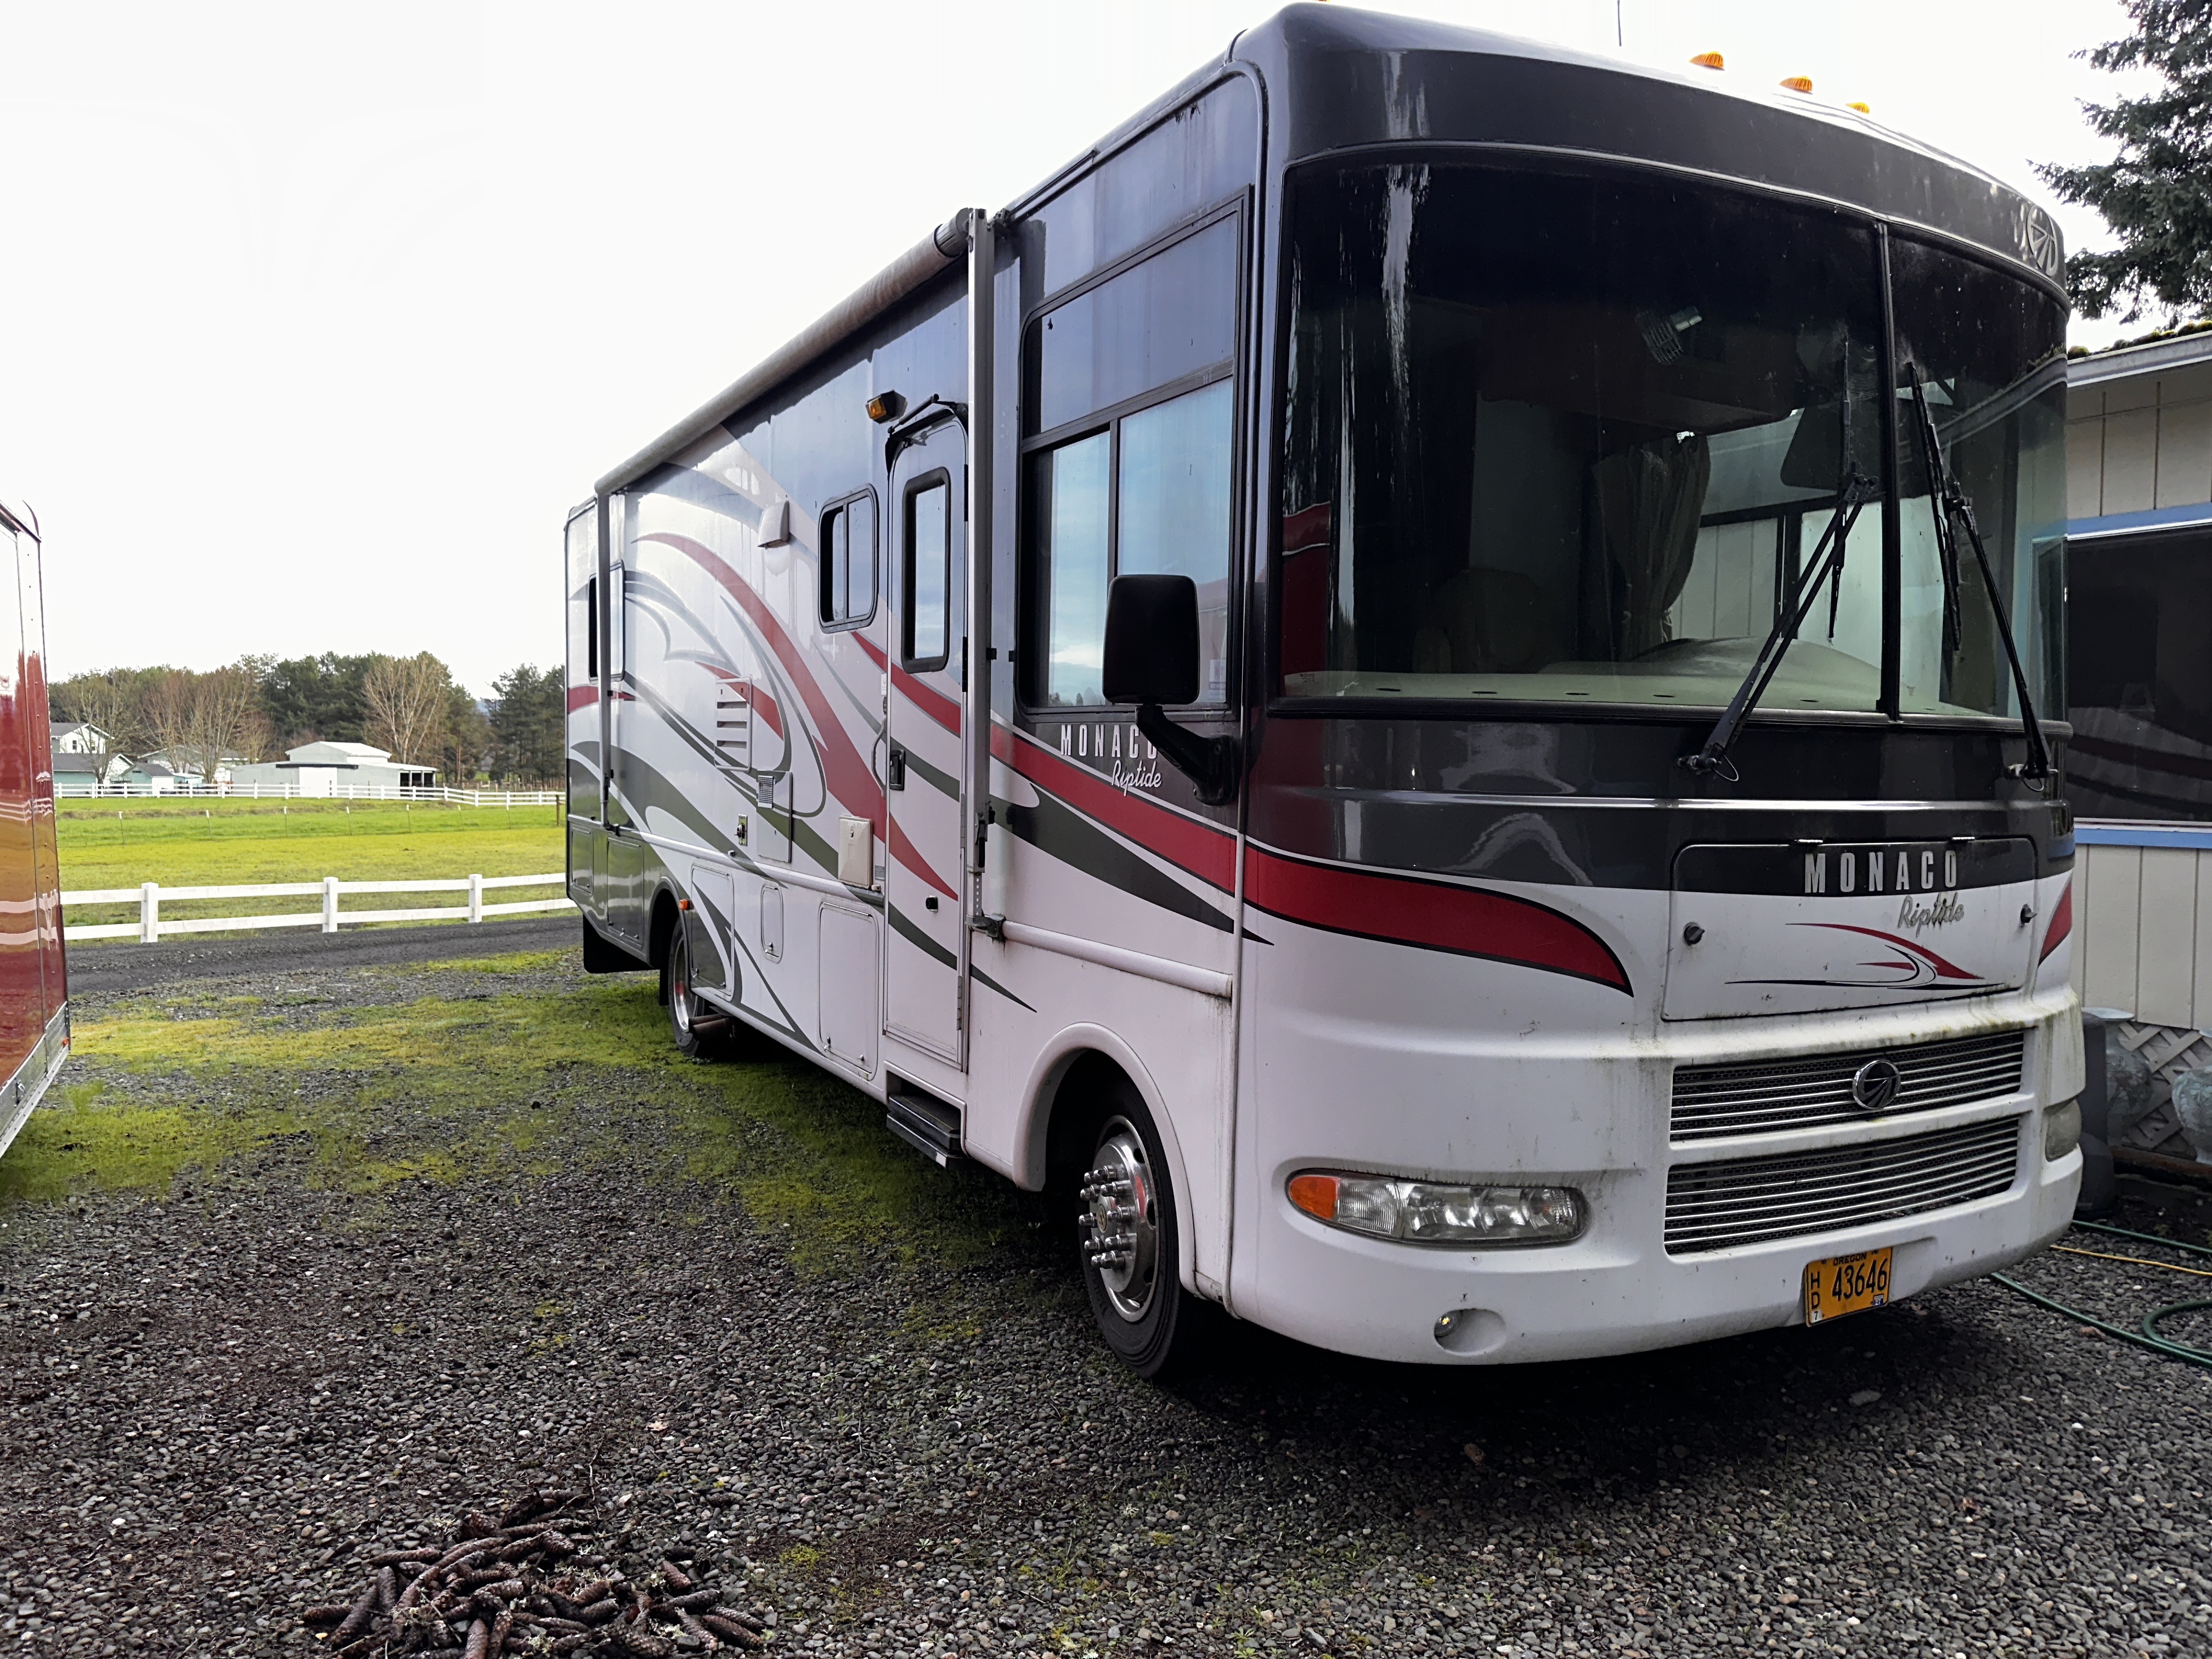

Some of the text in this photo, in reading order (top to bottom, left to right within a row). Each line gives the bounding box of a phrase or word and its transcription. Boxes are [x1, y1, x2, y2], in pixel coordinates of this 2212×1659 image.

[1111, 759, 1162, 797] Riptide
[1805, 850, 1956, 893] MONACO
[1898, 891, 1964, 938] Riptide
[1832, 1257, 1888, 1301] 43646
[1833, 1251, 1867, 1266] OREGON
